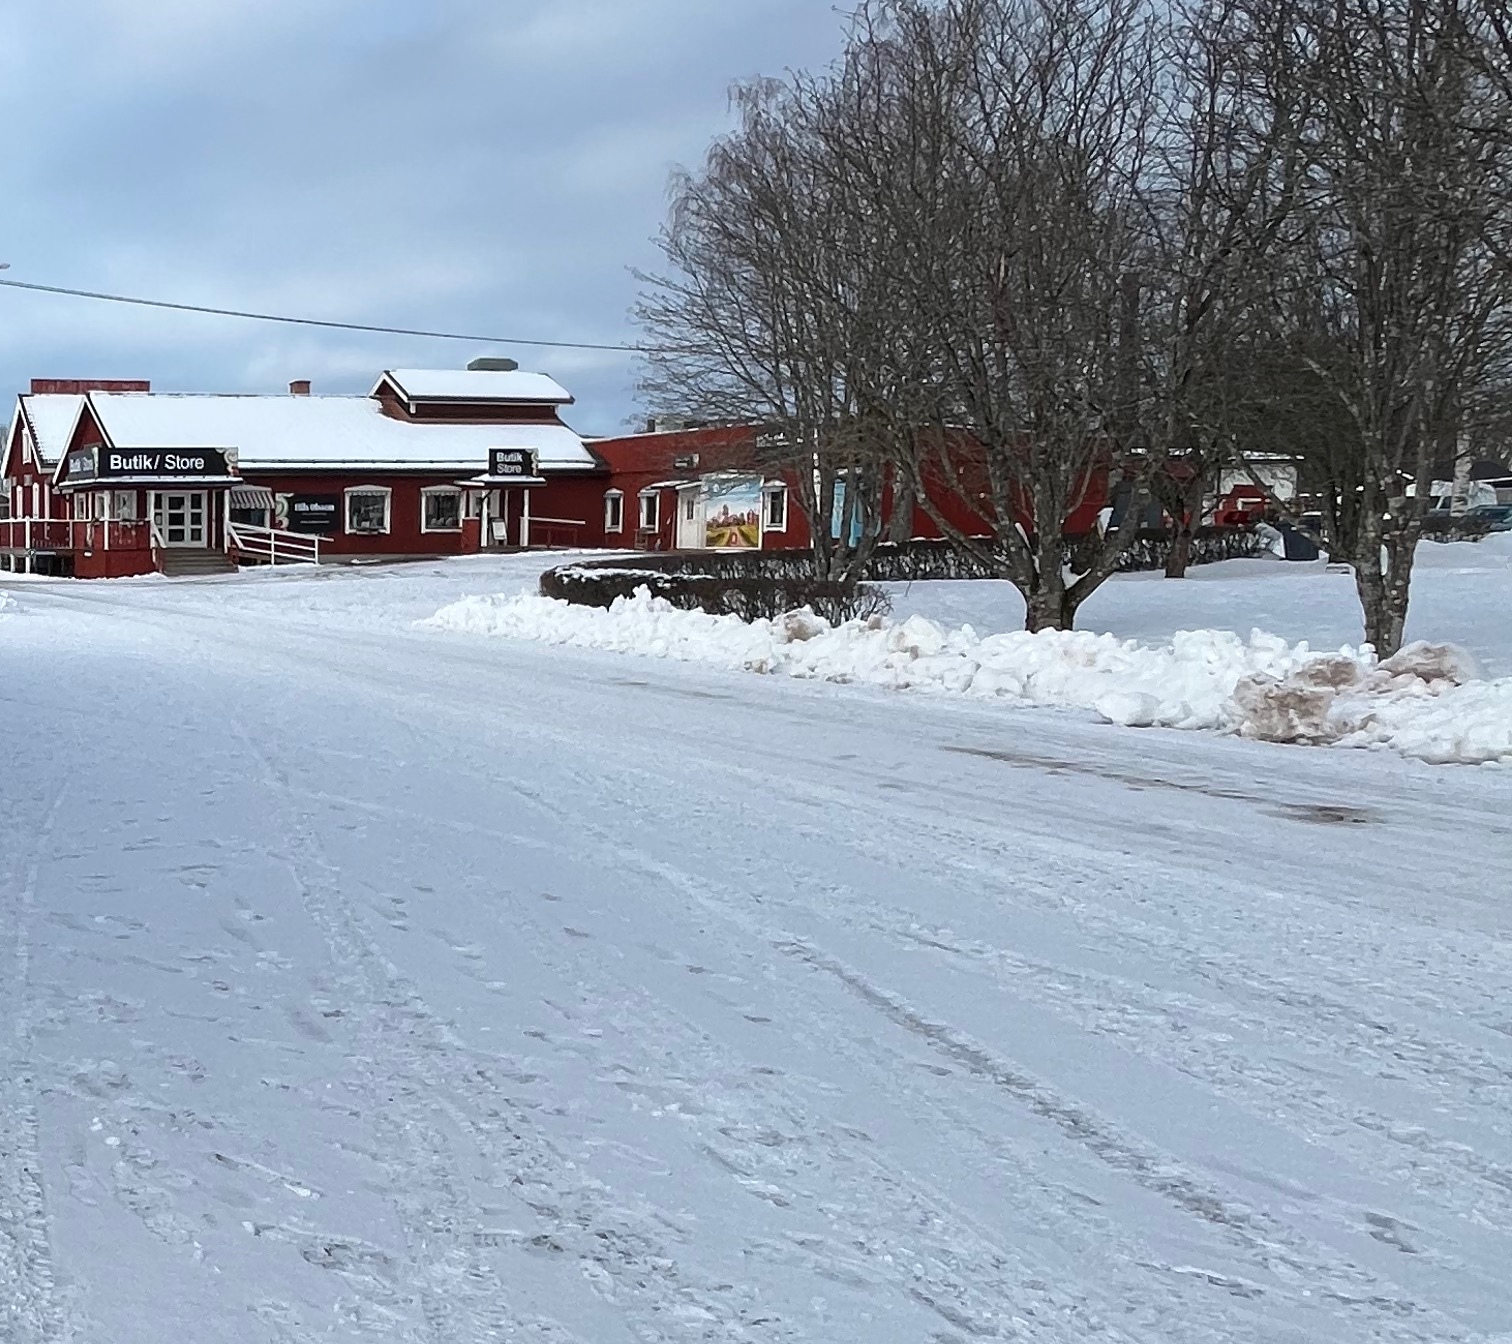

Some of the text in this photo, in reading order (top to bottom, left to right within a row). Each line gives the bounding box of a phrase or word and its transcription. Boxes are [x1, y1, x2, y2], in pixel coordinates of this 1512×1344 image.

[164, 454, 205, 470] Store
[496, 452, 523, 462] Butik
[496, 463, 522, 474] Store
